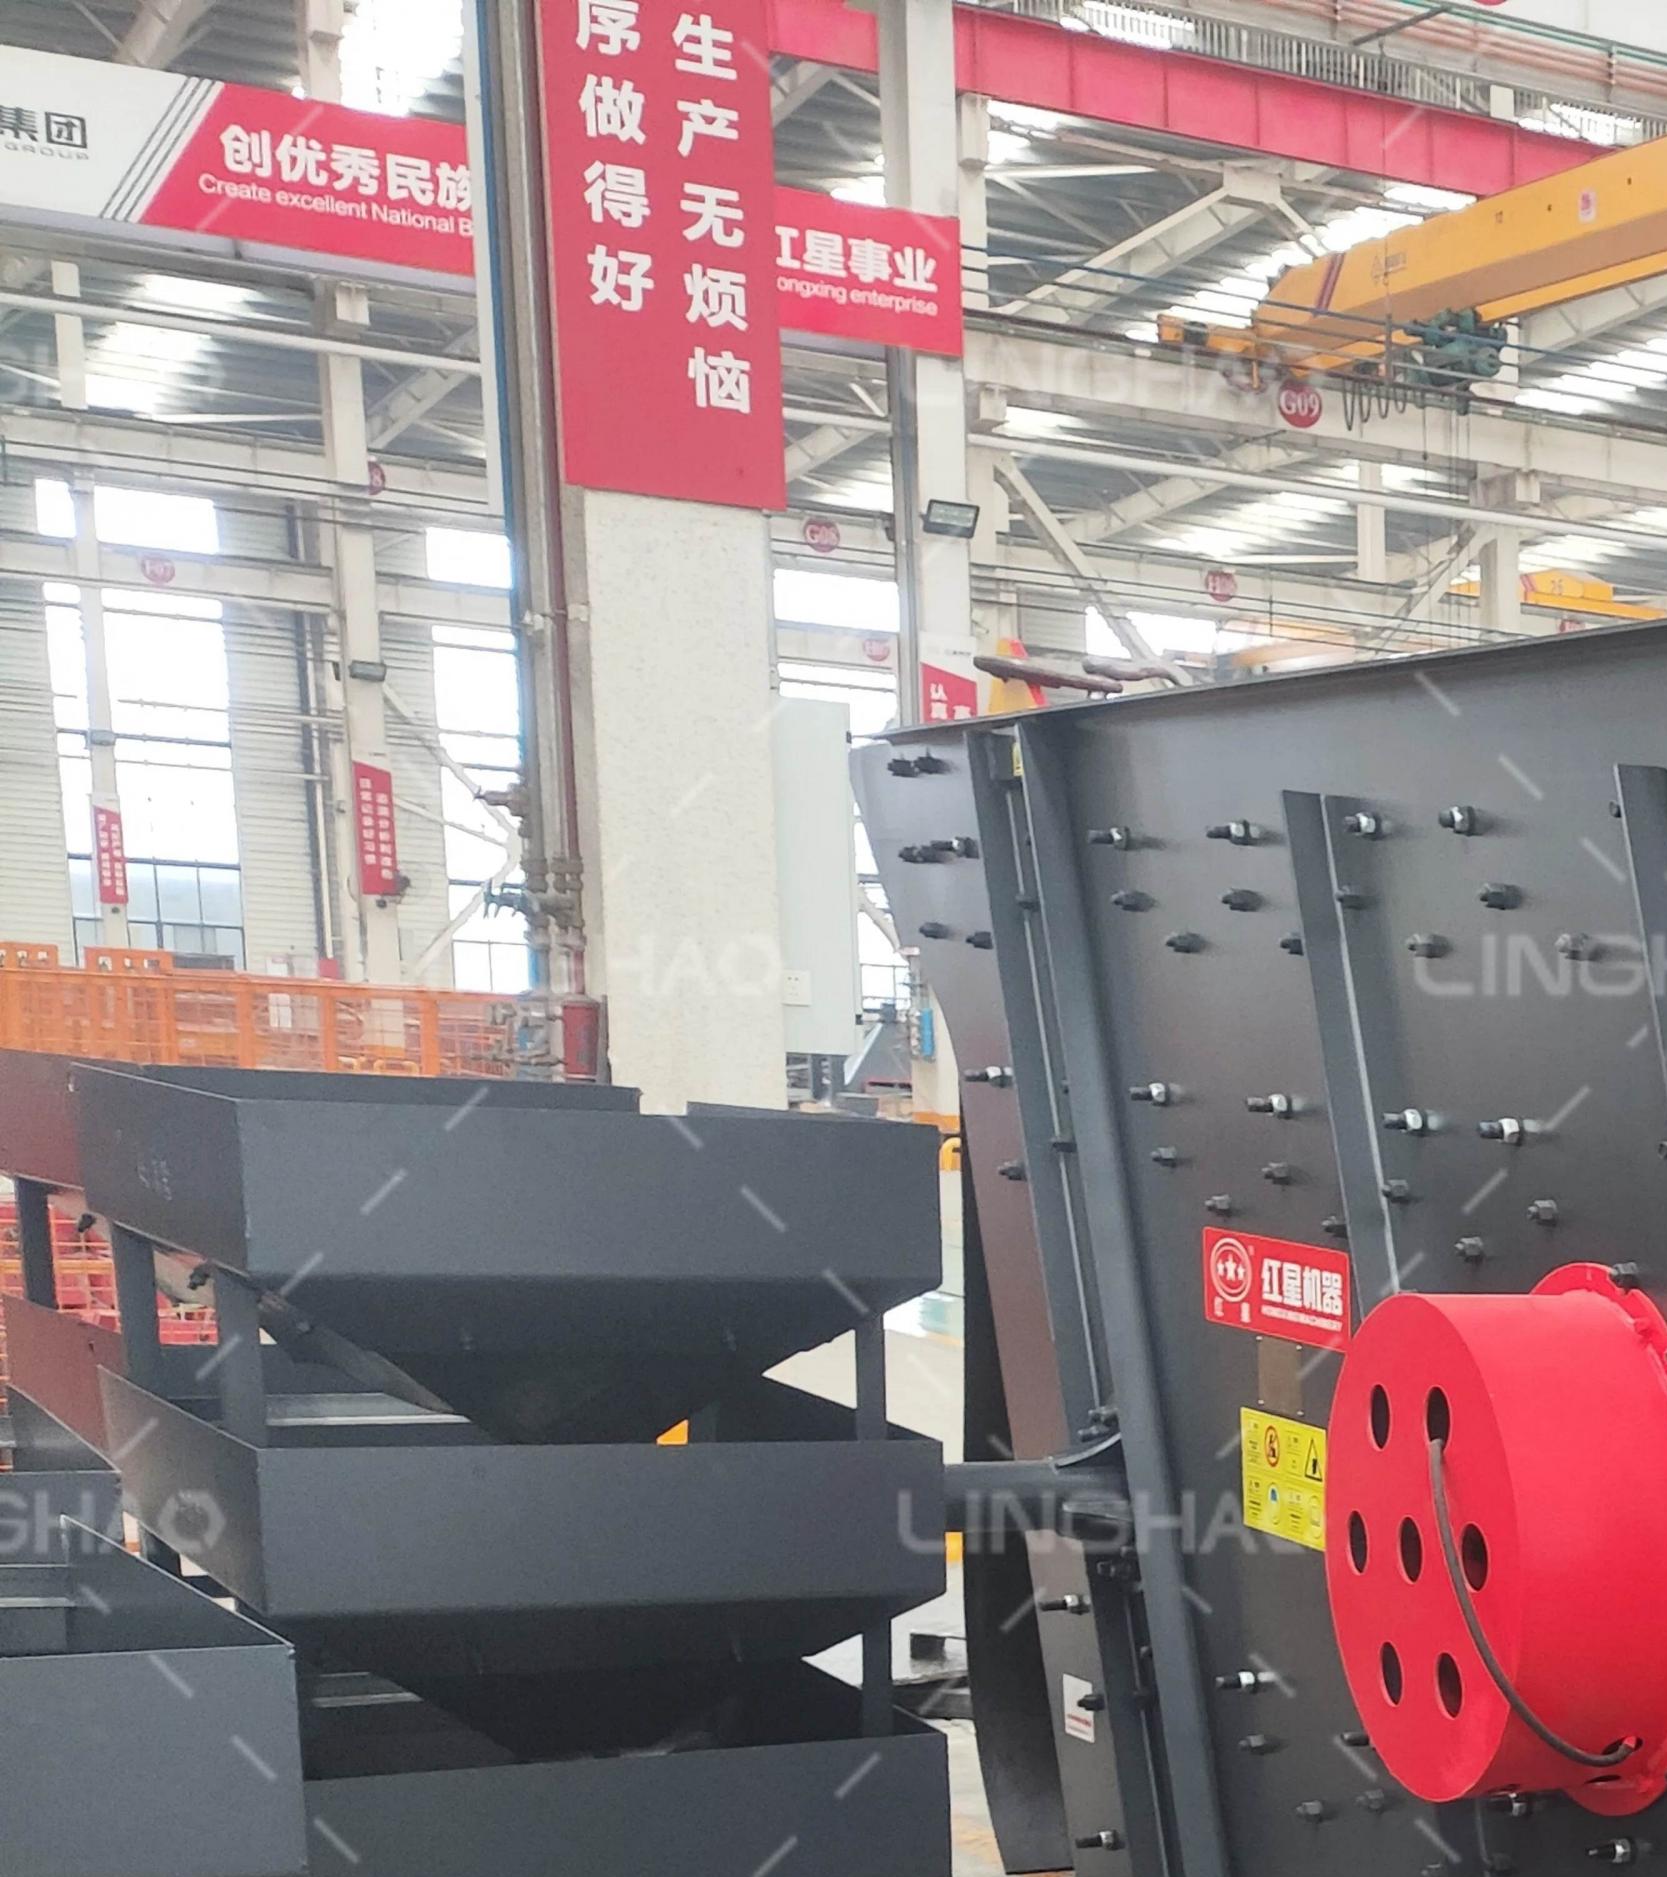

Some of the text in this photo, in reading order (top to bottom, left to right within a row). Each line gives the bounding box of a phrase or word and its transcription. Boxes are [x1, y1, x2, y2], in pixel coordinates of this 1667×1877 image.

[576, 0, 654, 313] 序做得好
[198, 173, 272, 204] Create
[275, 187, 369, 220] excellent
[371, 201, 456, 235] National
[672, 14, 752, 415] 生产无烦恼
[849, 288, 938, 317] enterprise
[1279, 388, 1320, 417] G09
[1261, 1257, 1343, 1317] 红星机器
